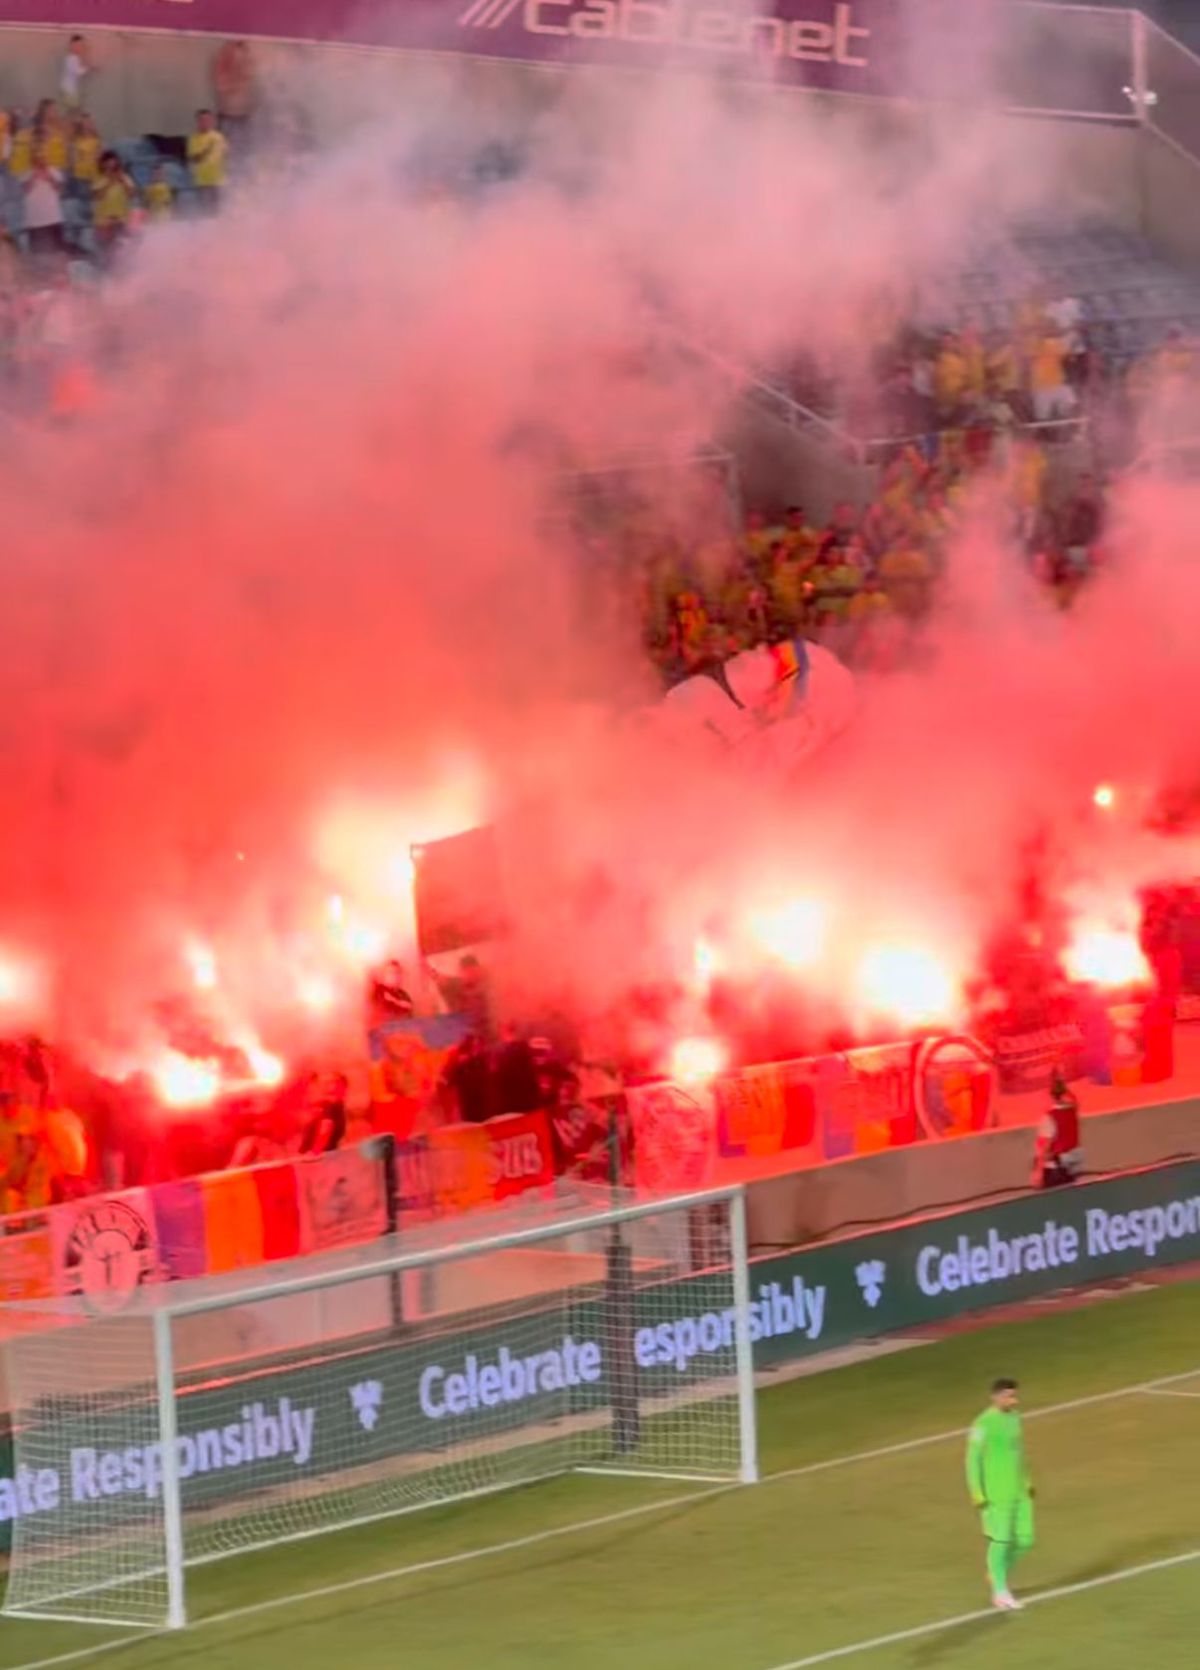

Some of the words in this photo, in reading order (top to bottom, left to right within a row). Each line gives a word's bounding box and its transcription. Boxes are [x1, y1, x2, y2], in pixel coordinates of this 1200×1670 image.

[916, 1220, 1079, 1297] Celebrate
[418, 1335, 601, 1419] Celebrate
[634, 1275, 826, 1371] esponsibly
[70, 1397, 316, 1500] Responsibly
